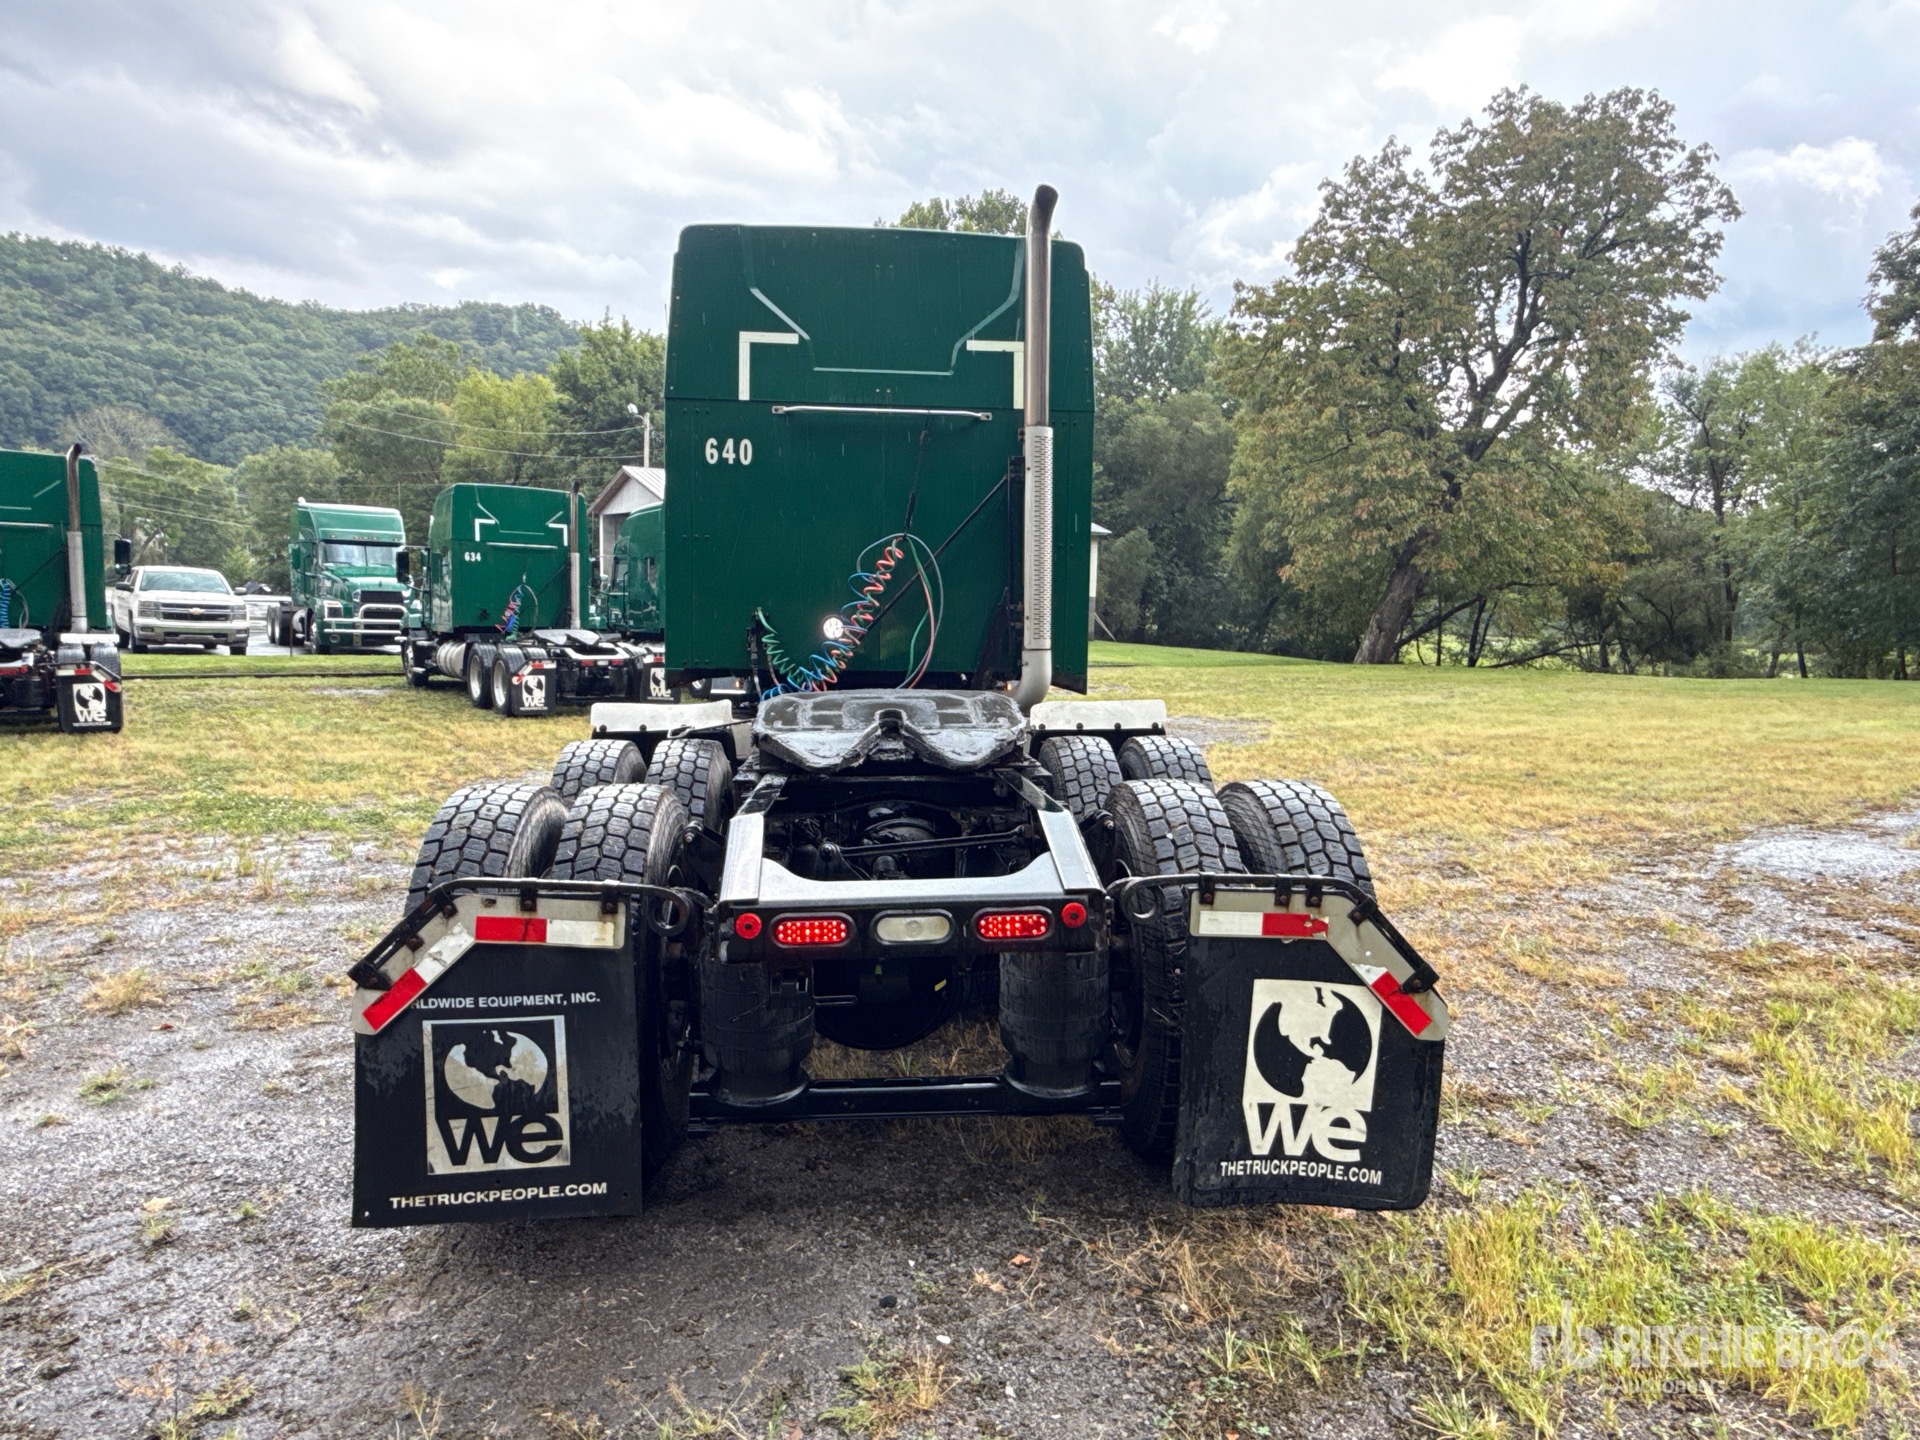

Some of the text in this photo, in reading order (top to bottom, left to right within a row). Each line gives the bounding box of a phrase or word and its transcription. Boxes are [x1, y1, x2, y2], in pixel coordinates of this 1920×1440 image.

[705, 437, 753, 466] 640
[464, 551, 482, 562] 634
[409, 991, 601, 1009] RLDWIDE EQUIPMENT, INC.
[1220, 1158, 1383, 1186] THETRUCKPEOPLE.COM
[389, 1182, 608, 1210] THETRUCKPEOPLE.COM
